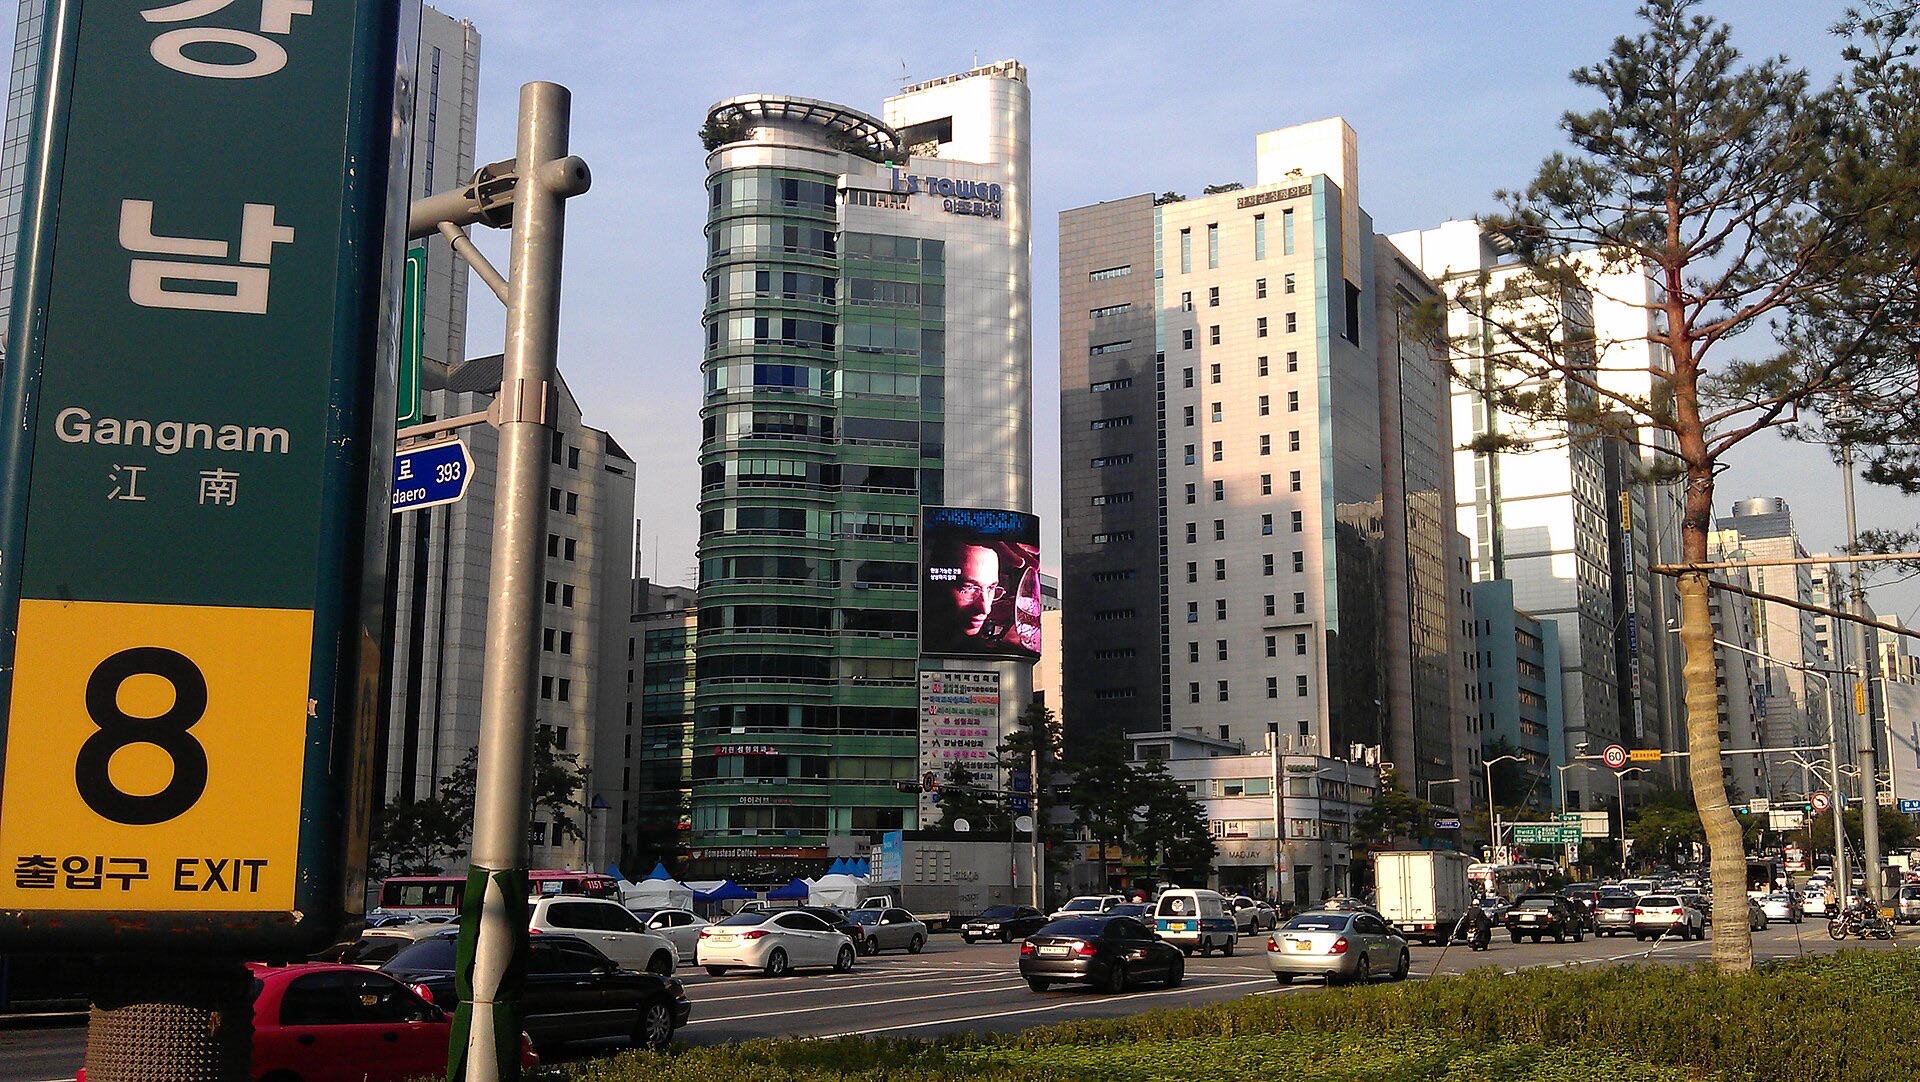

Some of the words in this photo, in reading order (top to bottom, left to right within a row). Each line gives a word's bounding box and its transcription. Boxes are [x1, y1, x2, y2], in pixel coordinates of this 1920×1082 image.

[926, 176, 1001, 202] TOWER
[54, 407, 290, 454] Gangnam
[107, 463, 240, 506] 江南
[436, 461, 461, 484] 393
[75, 646, 208, 826] 8
[1608, 751, 1621, 761] 60
[704, 848, 735, 858] Homestead
[736, 848, 757, 858] Coffee
[14, 855, 149, 891] 출입구
[174, 858, 268, 892] EXIT
[587, 880, 602, 889] 1151
